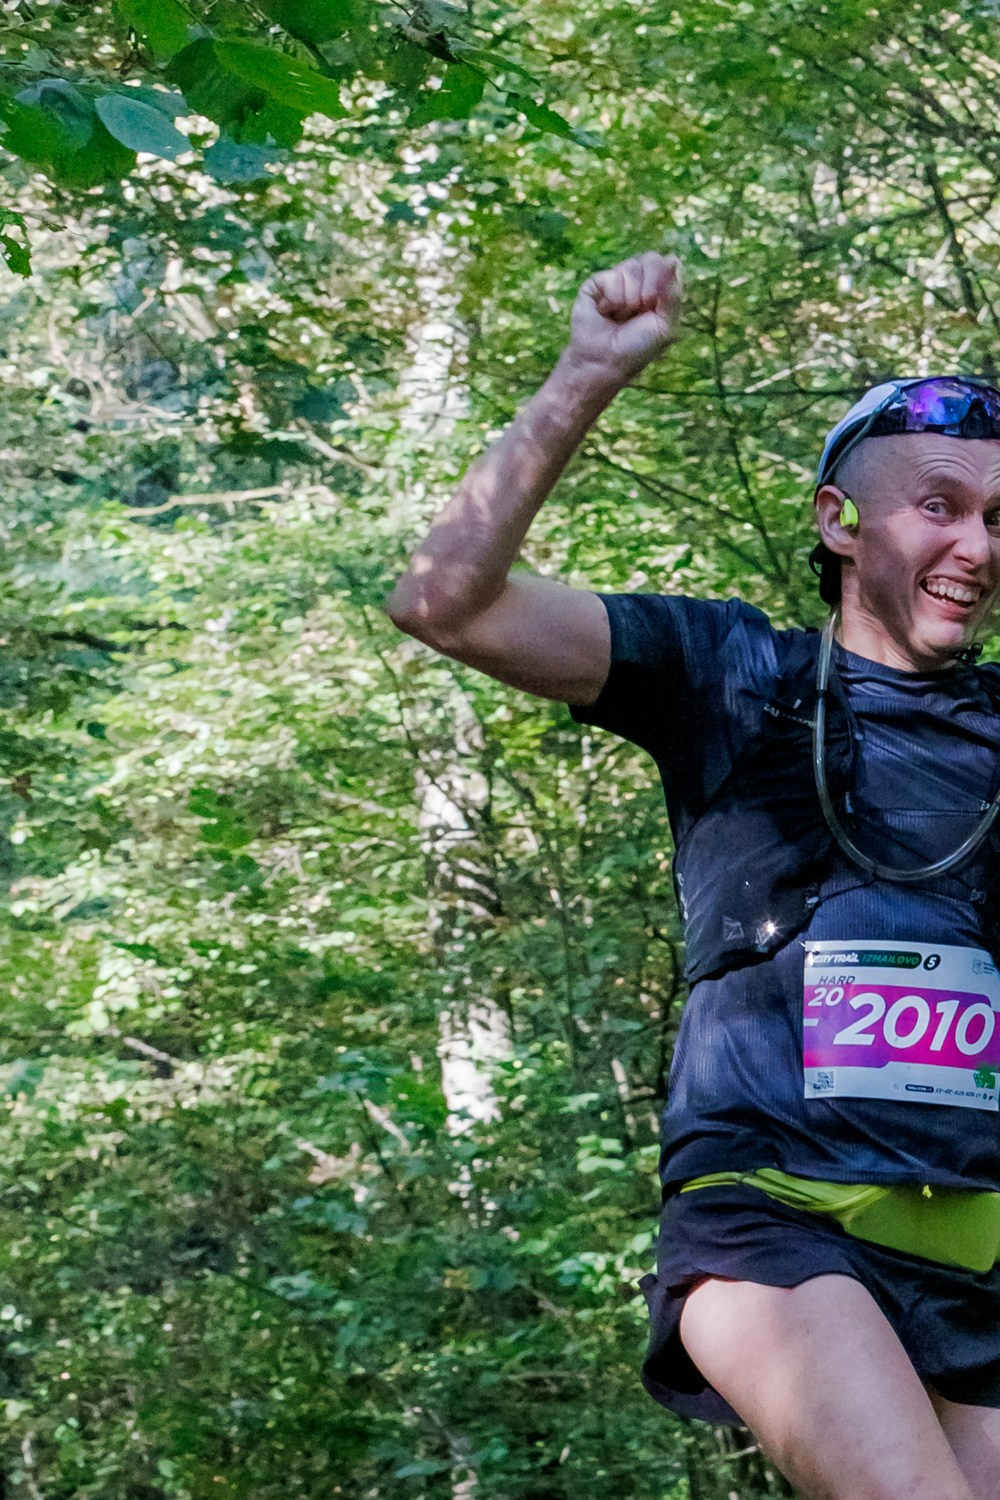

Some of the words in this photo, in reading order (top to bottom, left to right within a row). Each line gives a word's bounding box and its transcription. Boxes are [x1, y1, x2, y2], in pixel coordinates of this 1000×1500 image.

[861, 953, 920, 966] IZMAILOVO
[926, 956, 936, 968] 5
[818, 975, 856, 985] HARD
[808, 987, 844, 1007] 20
[832, 992, 996, 1056] 2010
